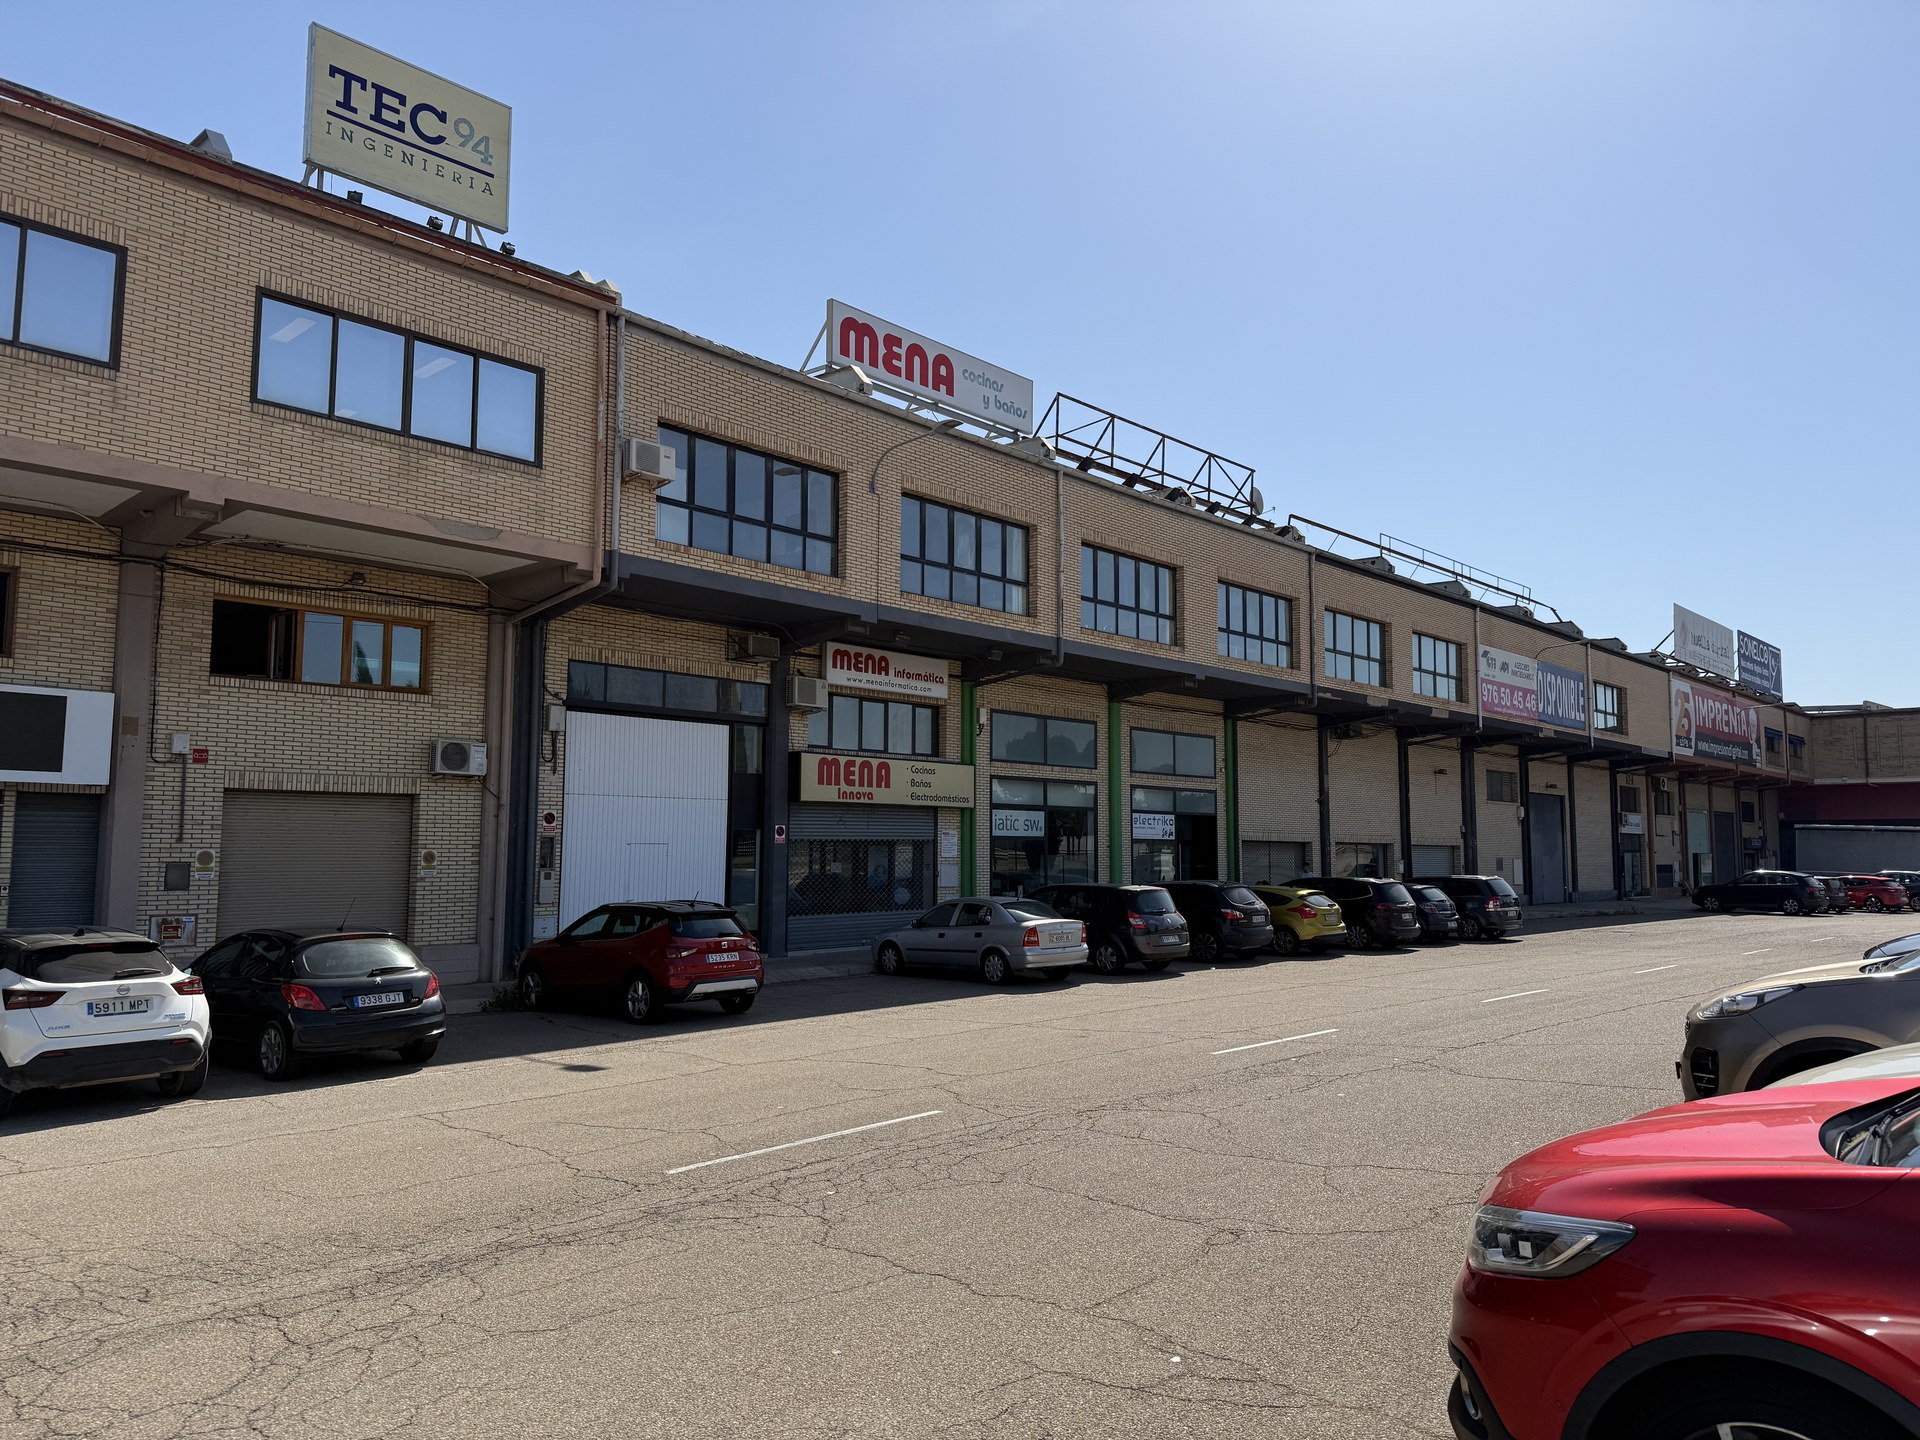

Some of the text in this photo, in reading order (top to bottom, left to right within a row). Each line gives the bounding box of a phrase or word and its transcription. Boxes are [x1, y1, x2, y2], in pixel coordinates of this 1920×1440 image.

[328, 63, 494, 167] TEC 94
[325, 120, 494, 196] INGENIERIA
[839, 316, 955, 398] MENA
[962, 367, 1005, 393] cocinas
[982, 394, 1028, 420] y baños
[832, 648, 945, 685] MENA informática
[1482, 682, 1498, 704] 976
[1500, 687, 1510, 706] 50
[1512, 690, 1523, 709] 45
[1538, 670, 1585, 721] DISPONIBLE
[1695, 695, 1748, 738] IMPRENTA
[817, 756, 891, 789] MENA
[910, 765, 936, 776] Cocinas
[910, 778, 932, 789] Baños
[837, 787, 874, 801] Innova
[910, 792, 970, 804] Electrodomésticos
[95, 998, 150, 1014] 5911 MPT
[360, 995, 383, 1006] 9338
[385, 992, 402, 1003] GJT
